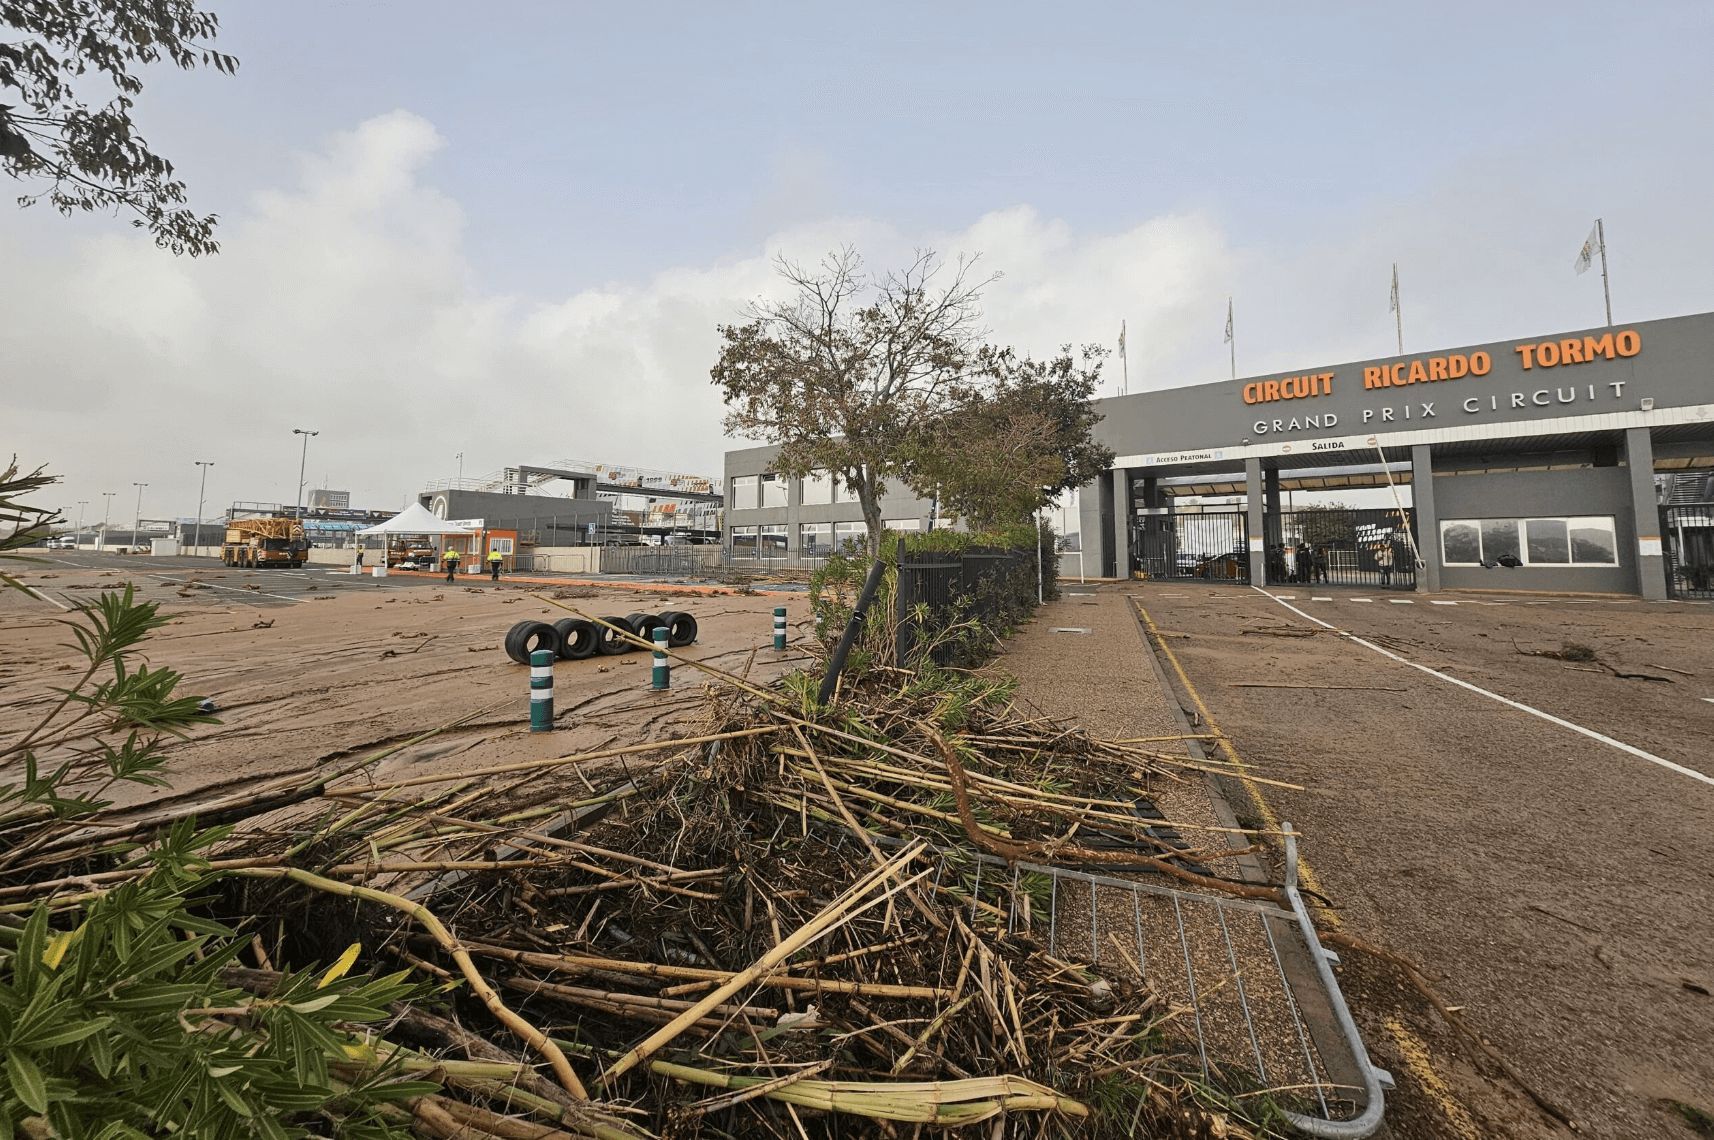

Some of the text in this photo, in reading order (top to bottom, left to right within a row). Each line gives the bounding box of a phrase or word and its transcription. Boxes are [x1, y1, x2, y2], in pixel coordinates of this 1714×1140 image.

[1243, 330, 1642, 404] CIRCUIT RICARDO TORMO
[1253, 381, 1626, 434] GRAND PRIX CIRCUIT
[1312, 441, 1345, 451] SALIDA
